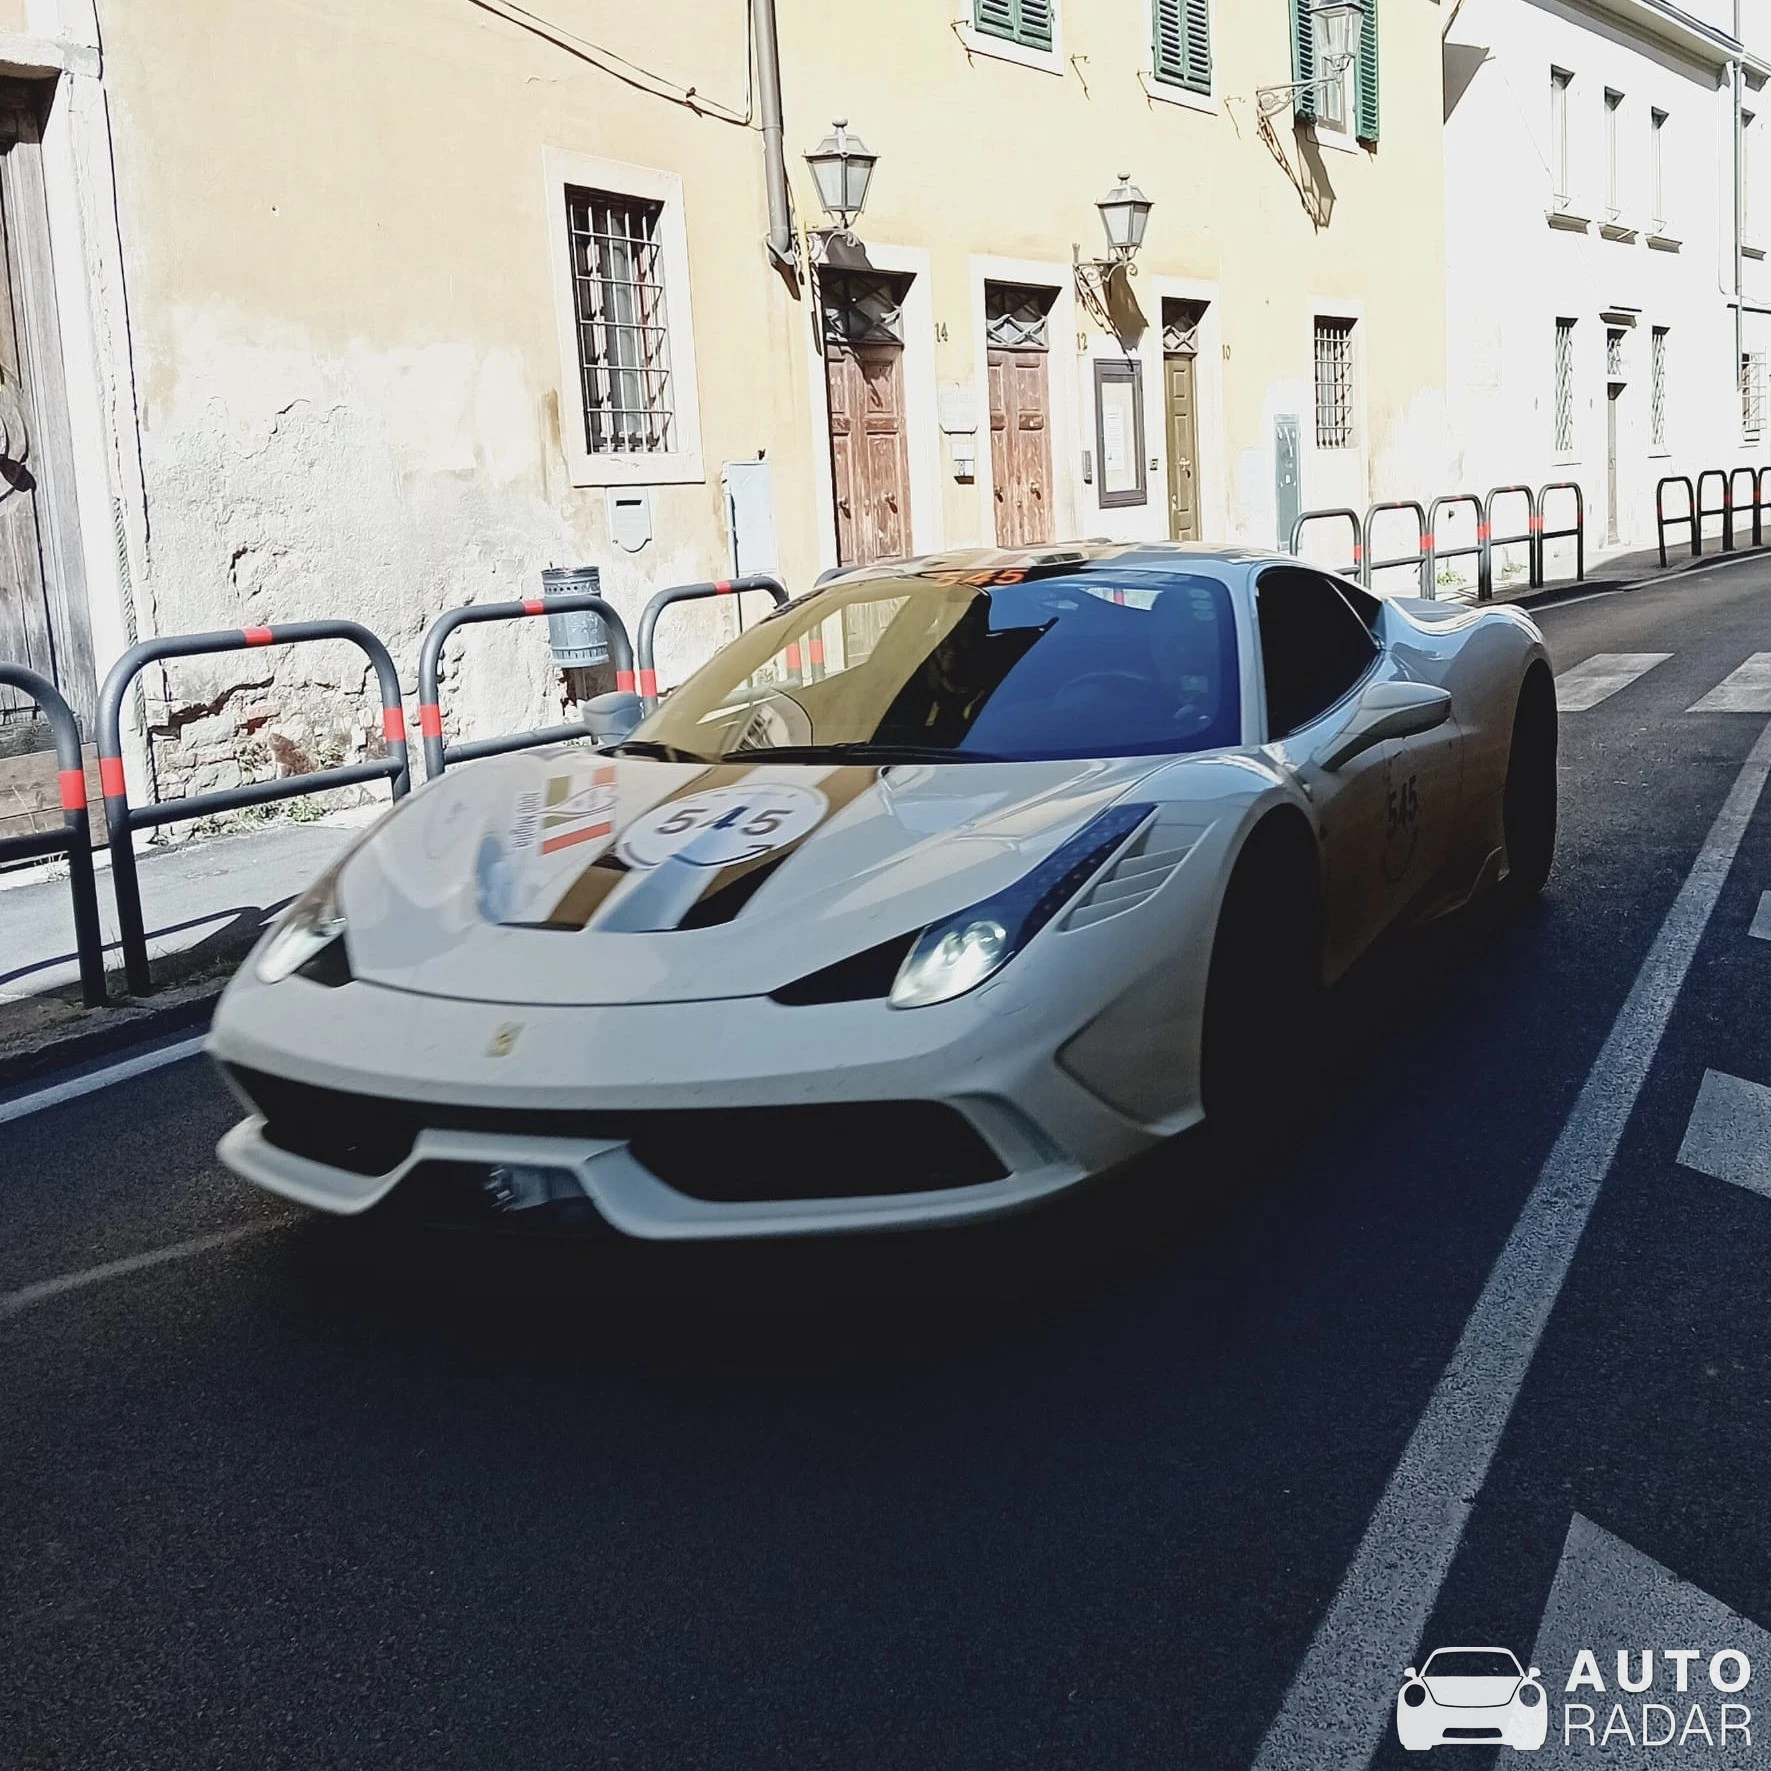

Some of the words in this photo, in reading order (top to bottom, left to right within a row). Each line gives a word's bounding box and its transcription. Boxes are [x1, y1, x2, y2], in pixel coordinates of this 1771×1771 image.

[934, 321, 948, 343] 14
[1076, 332, 1088, 351] 12
[1222, 344, 1231, 361] 10
[935, 568, 1029, 588] 545
[1387, 774, 1418, 832] 545
[654, 805, 794, 836] 545
